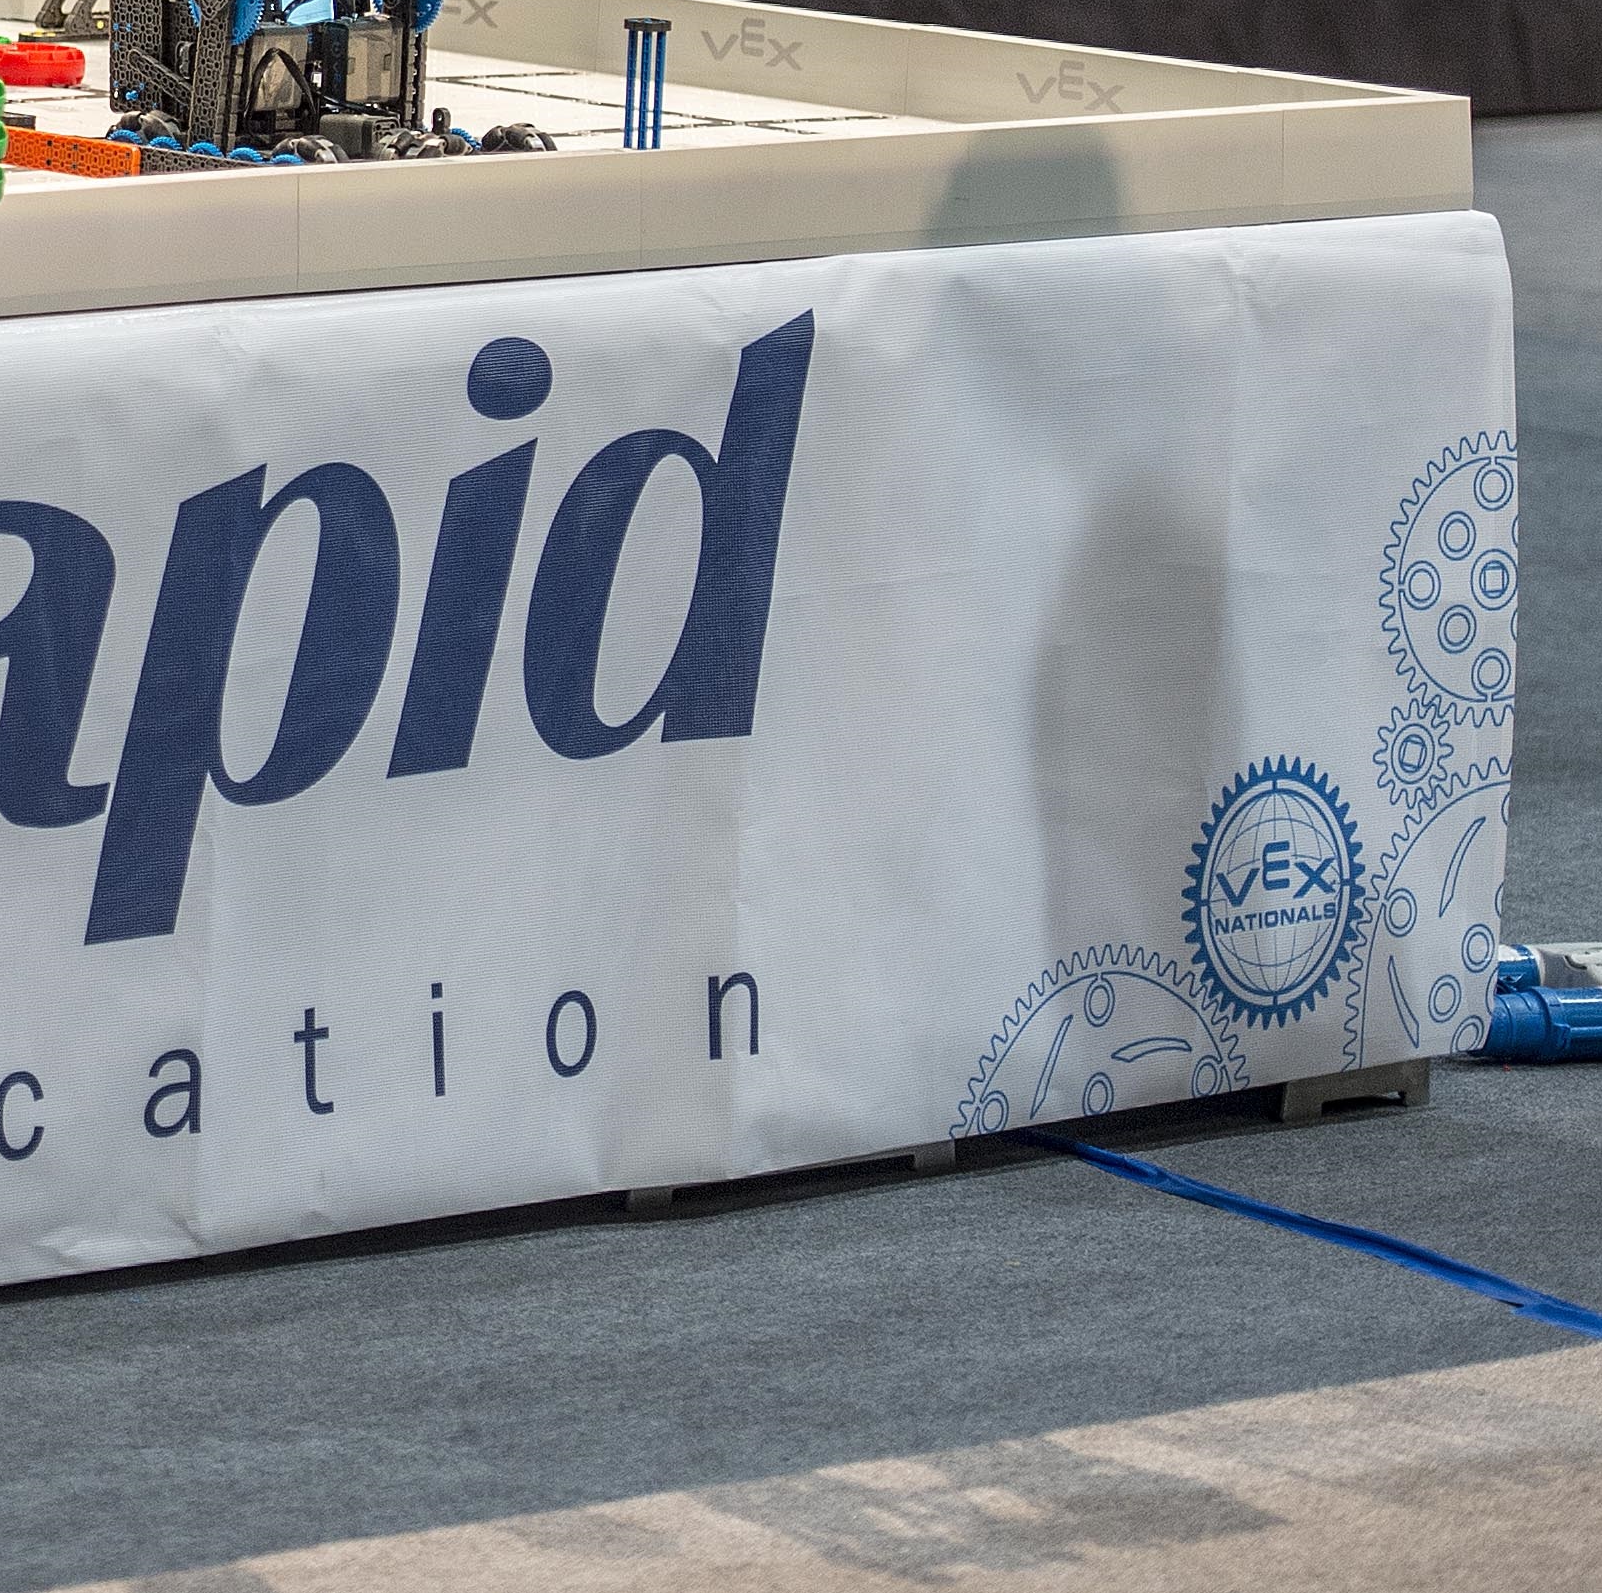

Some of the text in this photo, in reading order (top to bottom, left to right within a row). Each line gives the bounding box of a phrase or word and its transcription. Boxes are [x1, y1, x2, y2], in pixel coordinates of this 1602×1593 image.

[700, 17, 804, 71] VEX
[1016, 59, 1127, 114] VEX
[1216, 839, 1337, 908] VEX
[1214, 901, 1337, 937] NATIONALS
